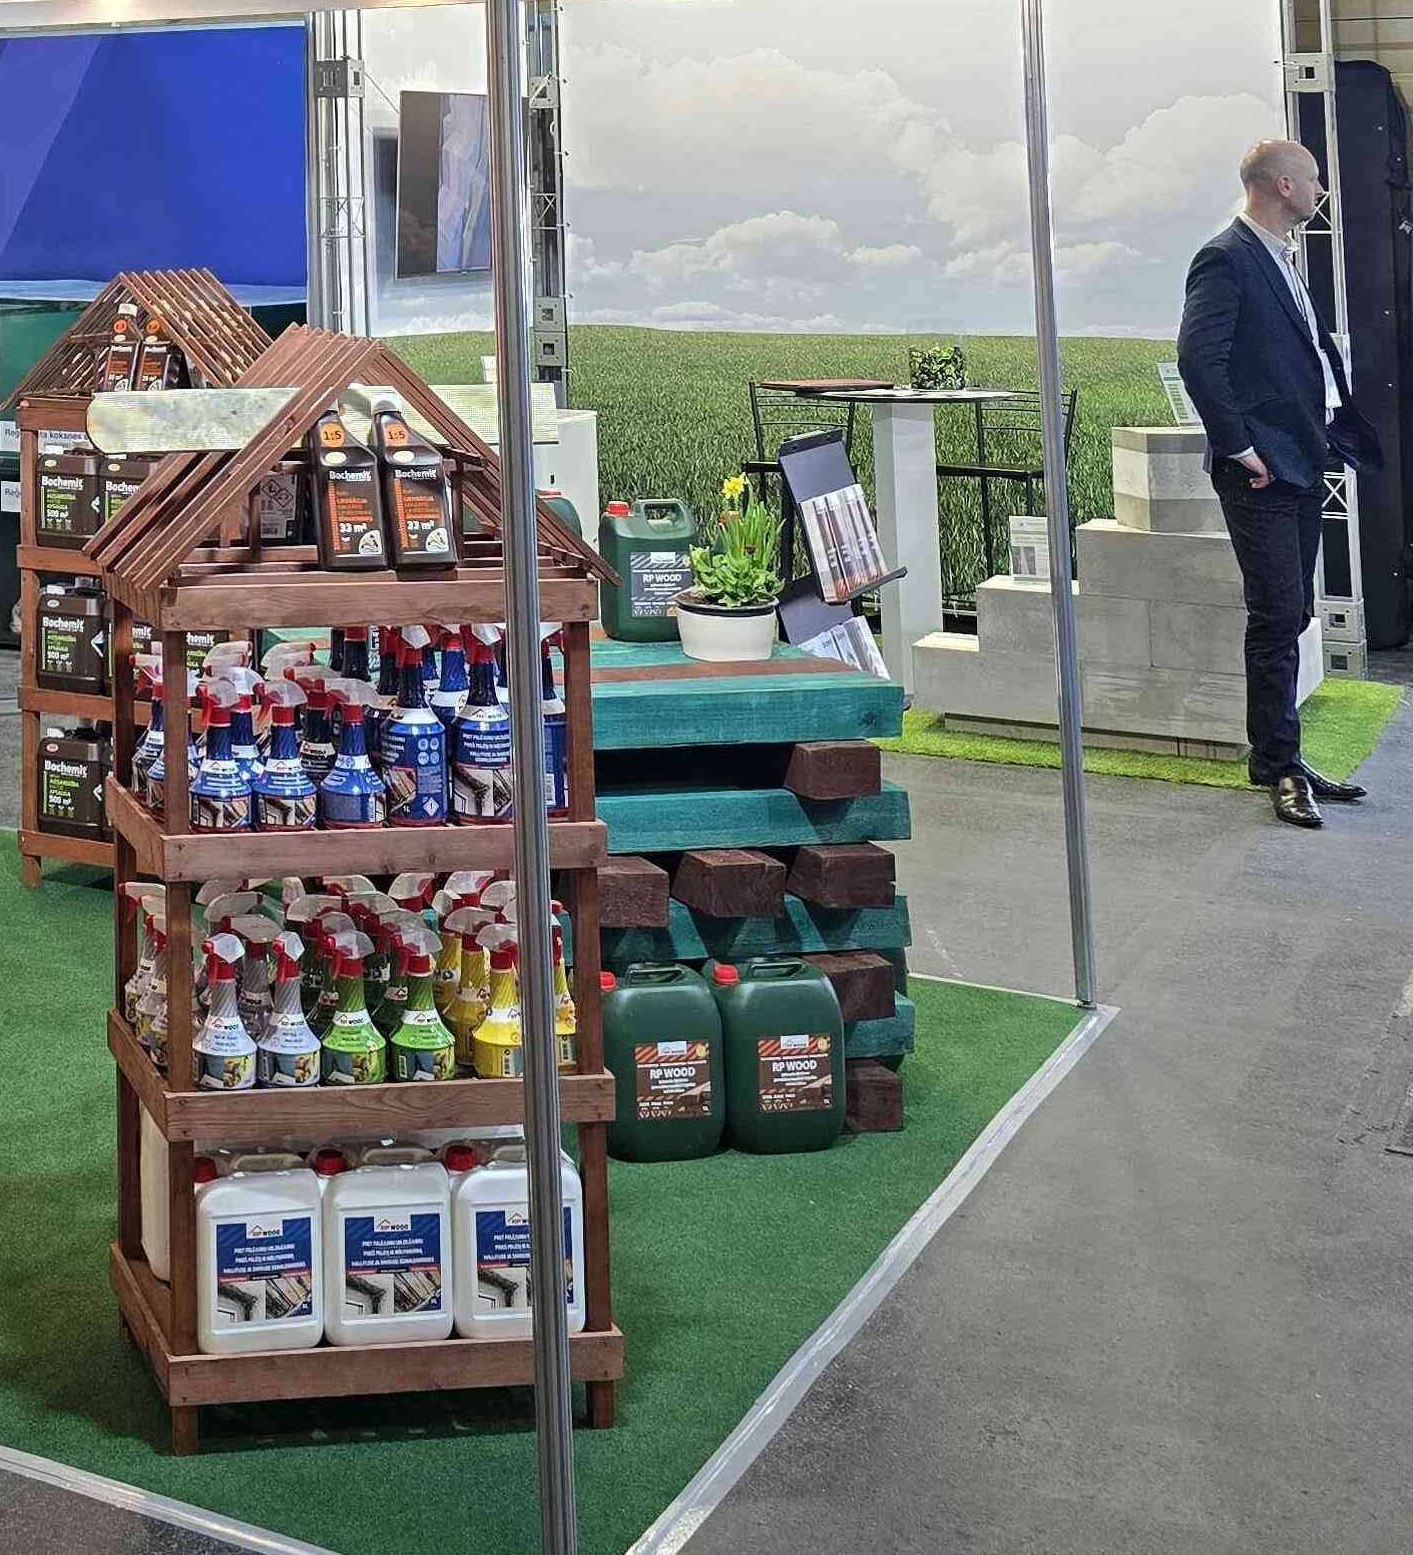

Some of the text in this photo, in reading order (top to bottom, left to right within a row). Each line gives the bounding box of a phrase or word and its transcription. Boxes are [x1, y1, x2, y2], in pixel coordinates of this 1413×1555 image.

[655, 572, 683, 584] WOOD
[771, 1059, 818, 1072] RP WOOD
[650, 1067, 696, 1080] RP WOOD
